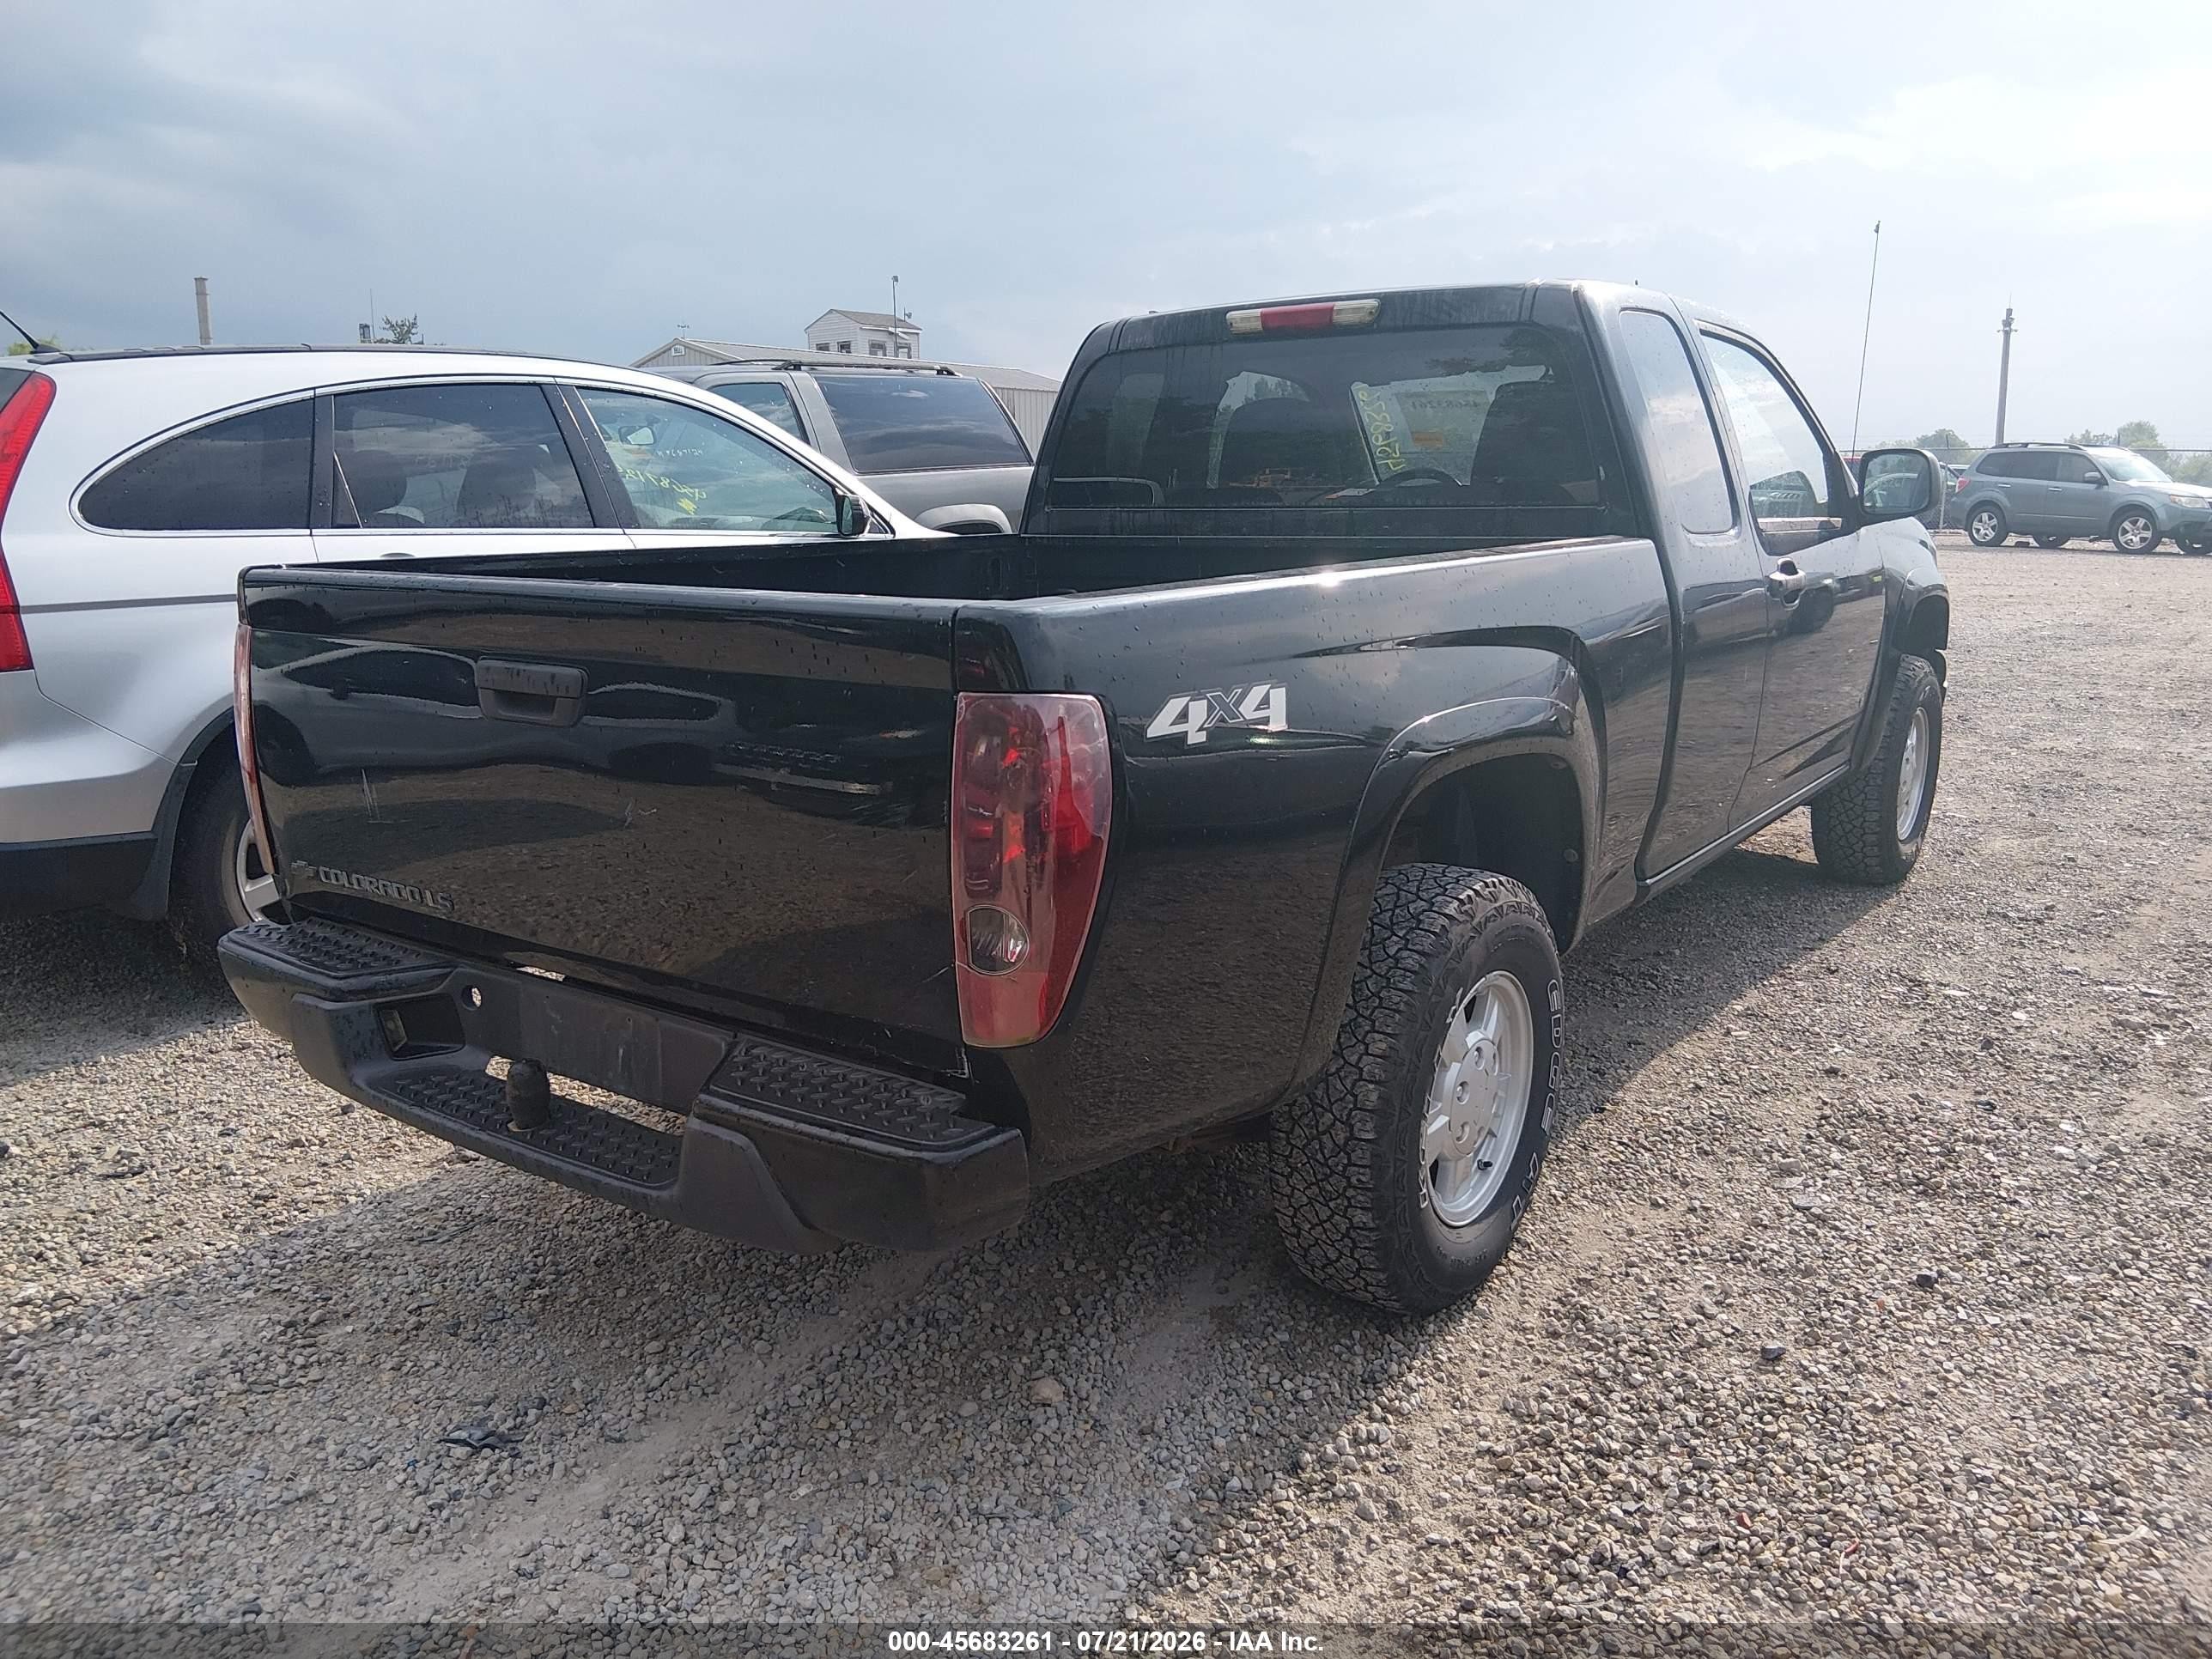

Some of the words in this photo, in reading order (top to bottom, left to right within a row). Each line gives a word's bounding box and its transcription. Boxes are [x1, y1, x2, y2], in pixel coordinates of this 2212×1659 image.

[319, 866, 423, 905] COLORADO
[425, 890, 455, 914] LS
[1540, 979, 1563, 1136] EDGE
